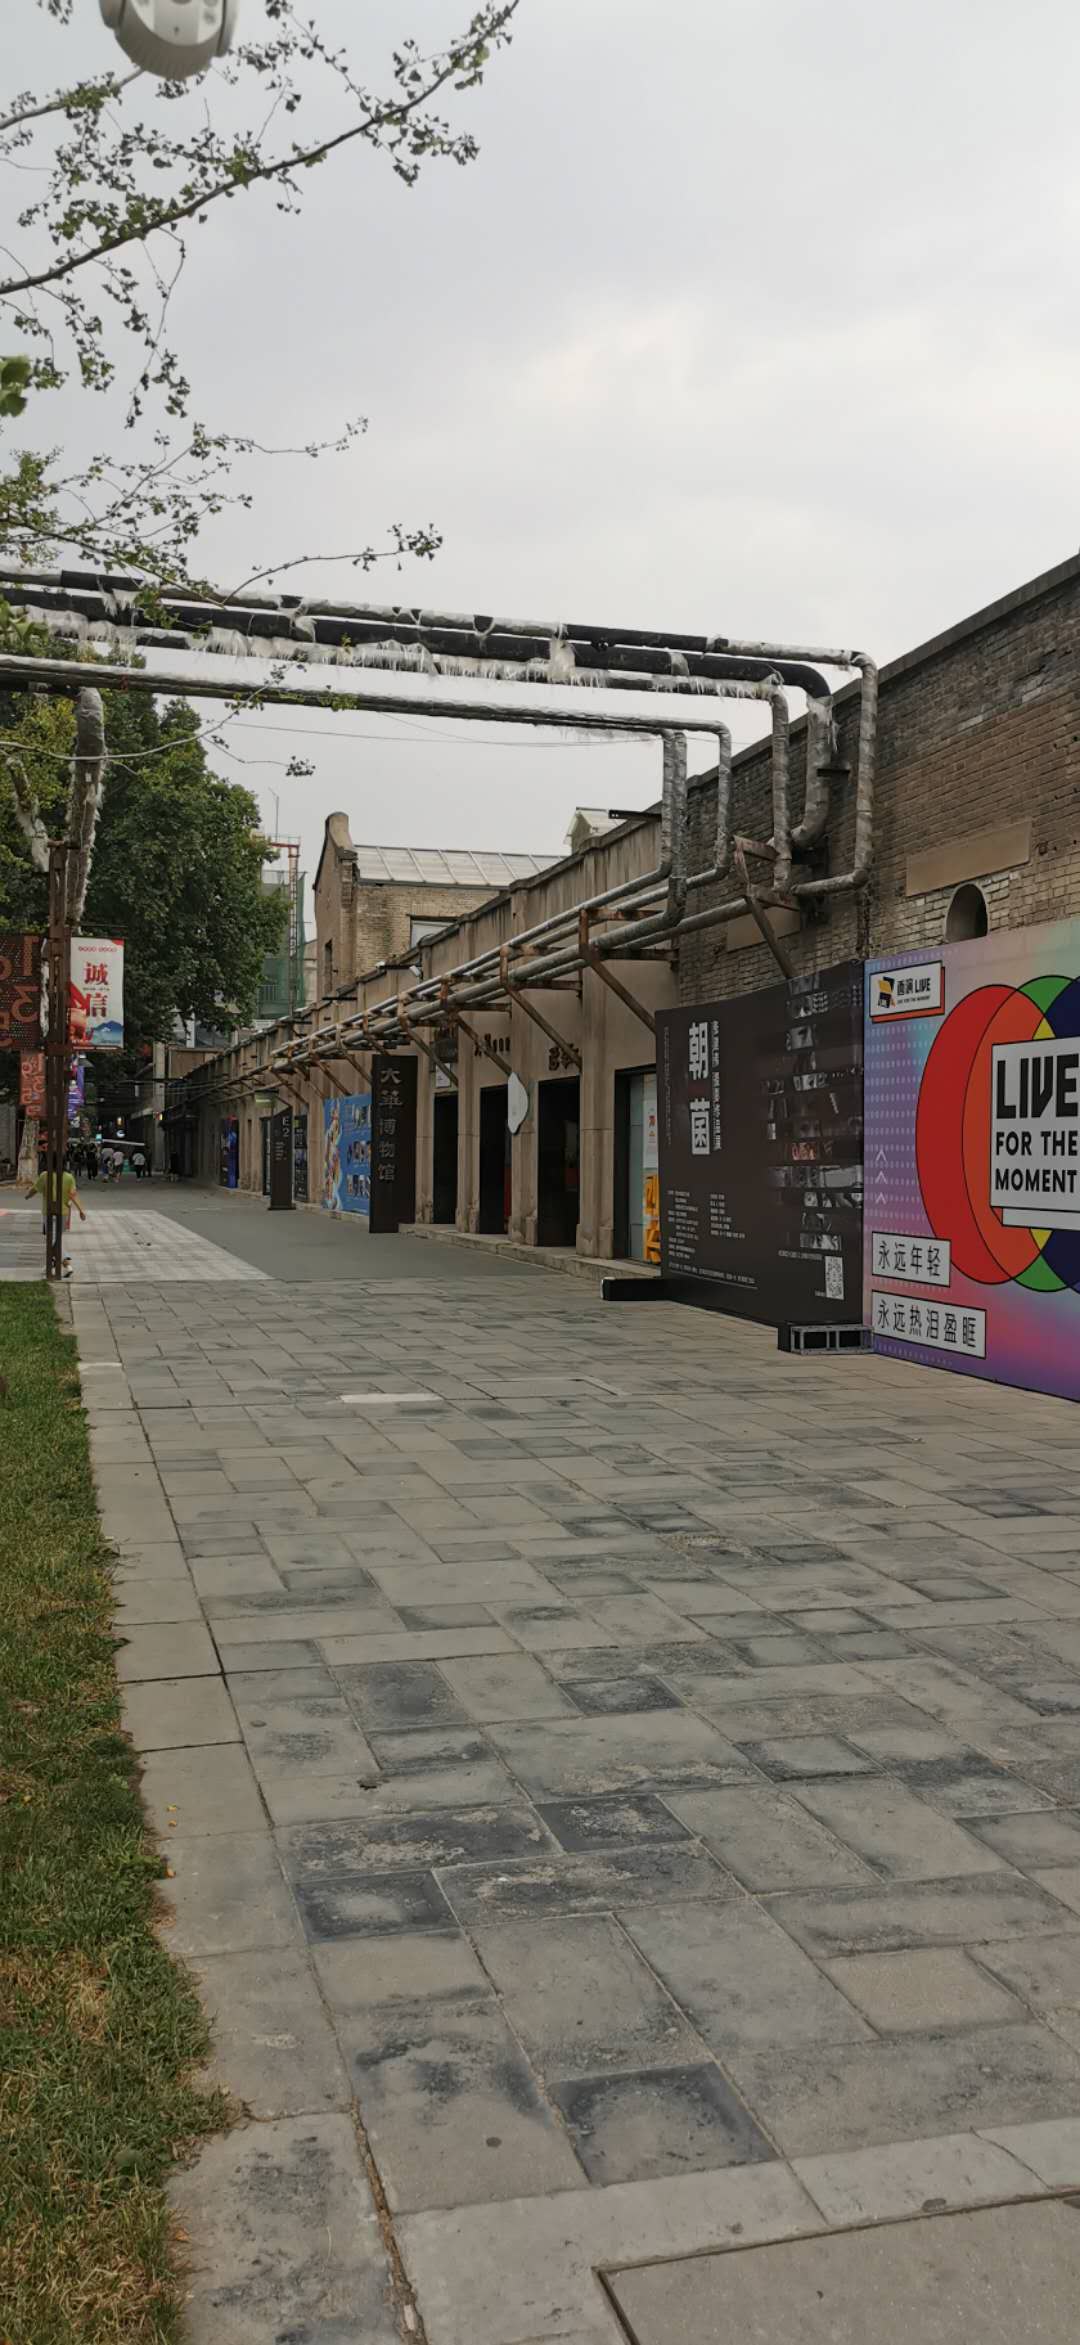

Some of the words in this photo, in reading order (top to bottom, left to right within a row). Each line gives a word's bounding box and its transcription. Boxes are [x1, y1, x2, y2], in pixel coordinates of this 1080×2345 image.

[915, 977, 931, 993] LIVE
[688, 1021, 710, 1155] 朝菌
[996, 1053, 1079, 1119] LIVE
[996, 1130, 1032, 1156] FOR
[1041, 1130, 1078, 1156] THE
[995, 1168, 1077, 1193] MOMENT
[877, 1240, 941, 1277] 永远年轻
[877, 1299, 977, 1348] 永远热泪盈眶
